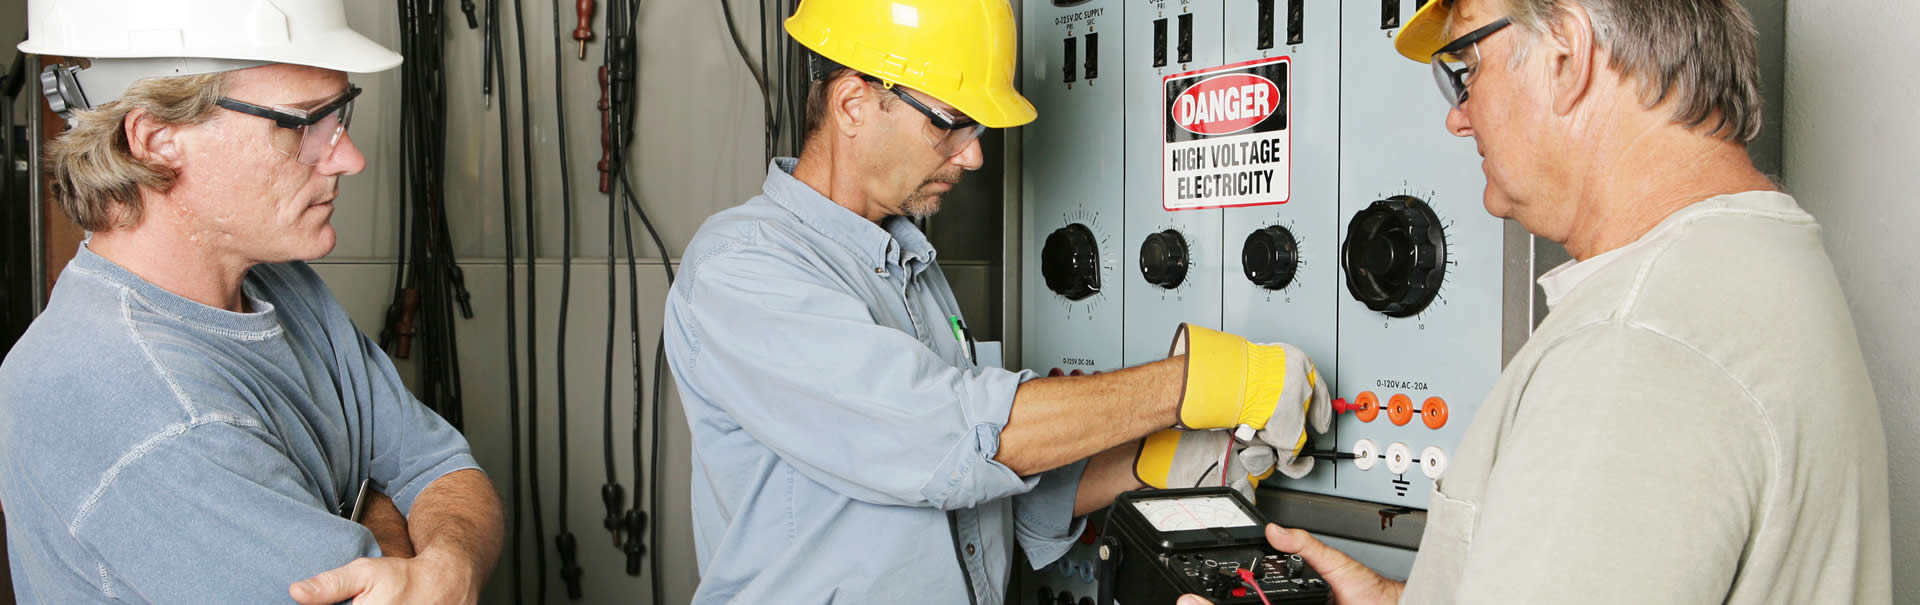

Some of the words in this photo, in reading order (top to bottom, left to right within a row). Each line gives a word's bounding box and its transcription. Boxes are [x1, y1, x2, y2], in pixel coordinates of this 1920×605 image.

[1084, 8, 1104, 19] SUPPLY
[1181, 83, 1270, 126] DANGER
[1172, 146, 1206, 172] HIGH
[1211, 138, 1280, 168] VOLTAGE
[1178, 169, 1274, 200] ELECTRICITY
